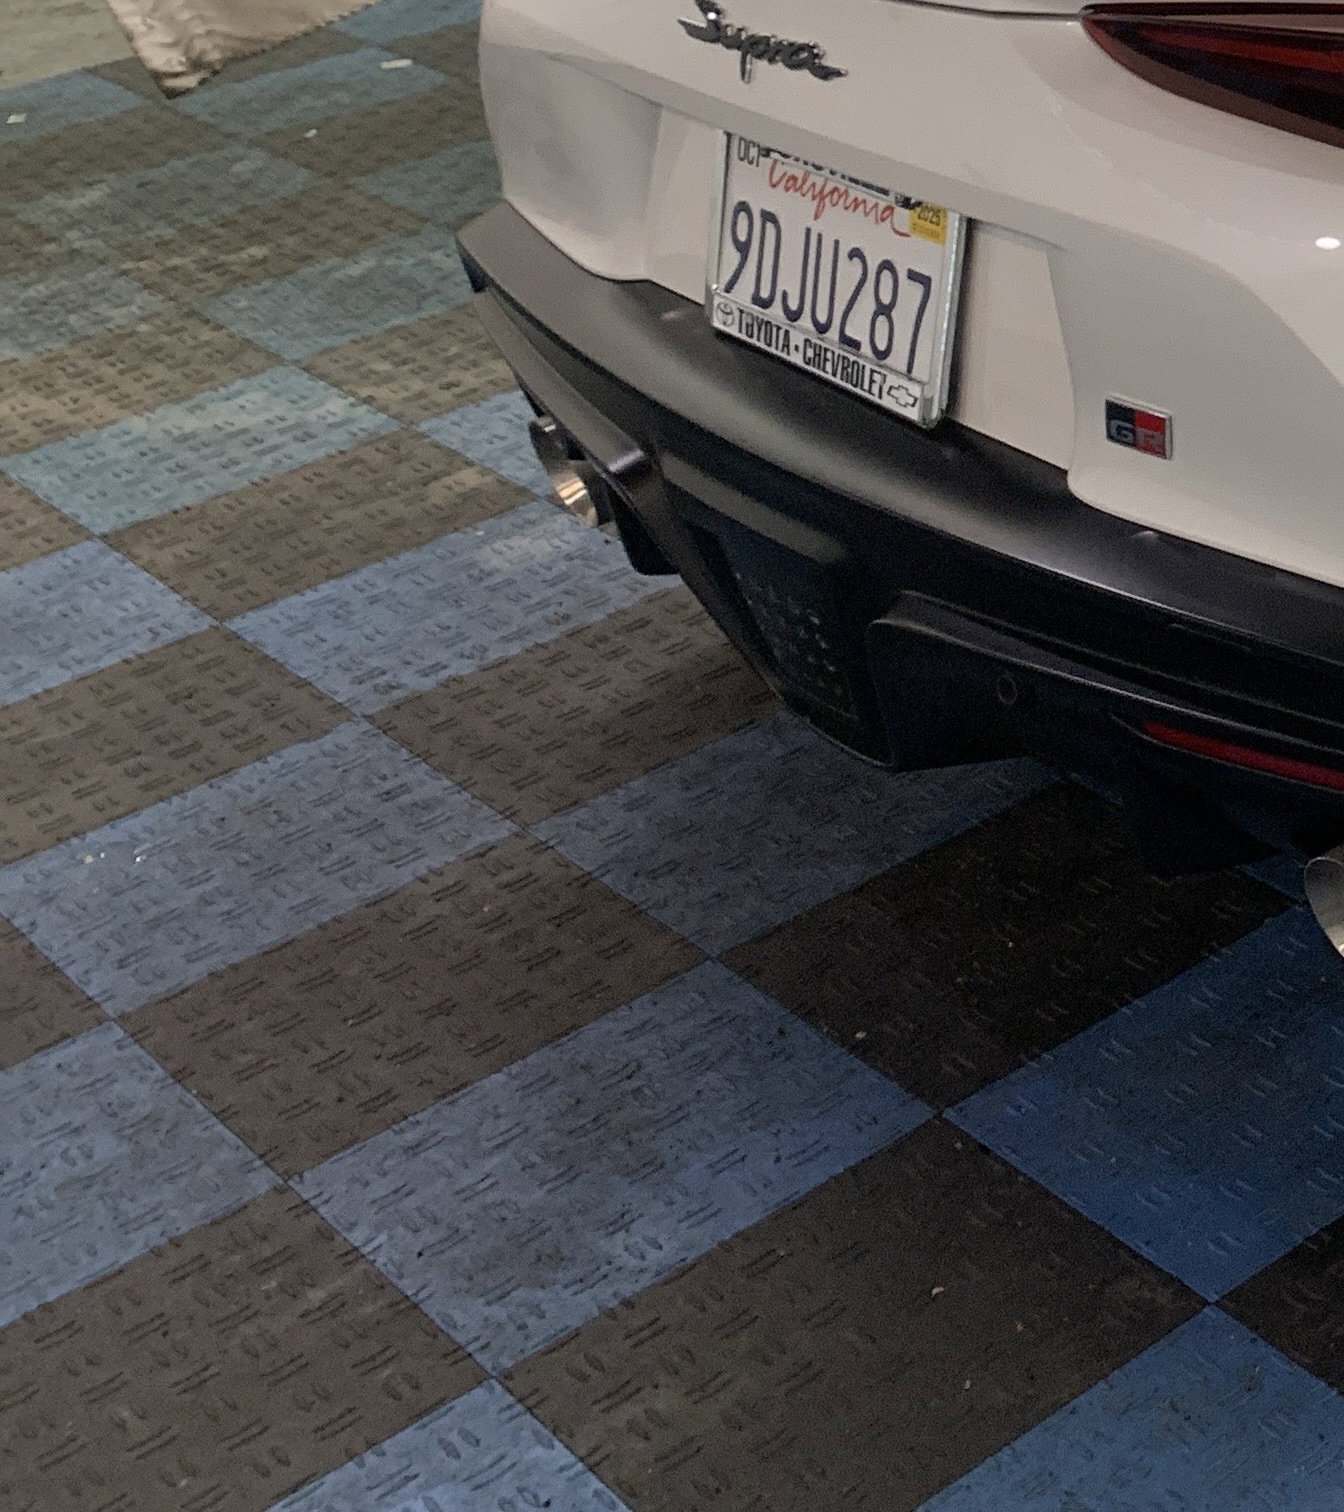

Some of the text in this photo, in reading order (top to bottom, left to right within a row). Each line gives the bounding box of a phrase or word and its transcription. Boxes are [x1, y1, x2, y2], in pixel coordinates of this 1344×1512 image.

[769, 159, 911, 238] California
[723, 200, 932, 375] 9DJU287
[737, 308, 887, 400] TOYOTA CHEVROLET
[1110, 419, 1166, 456] GR
